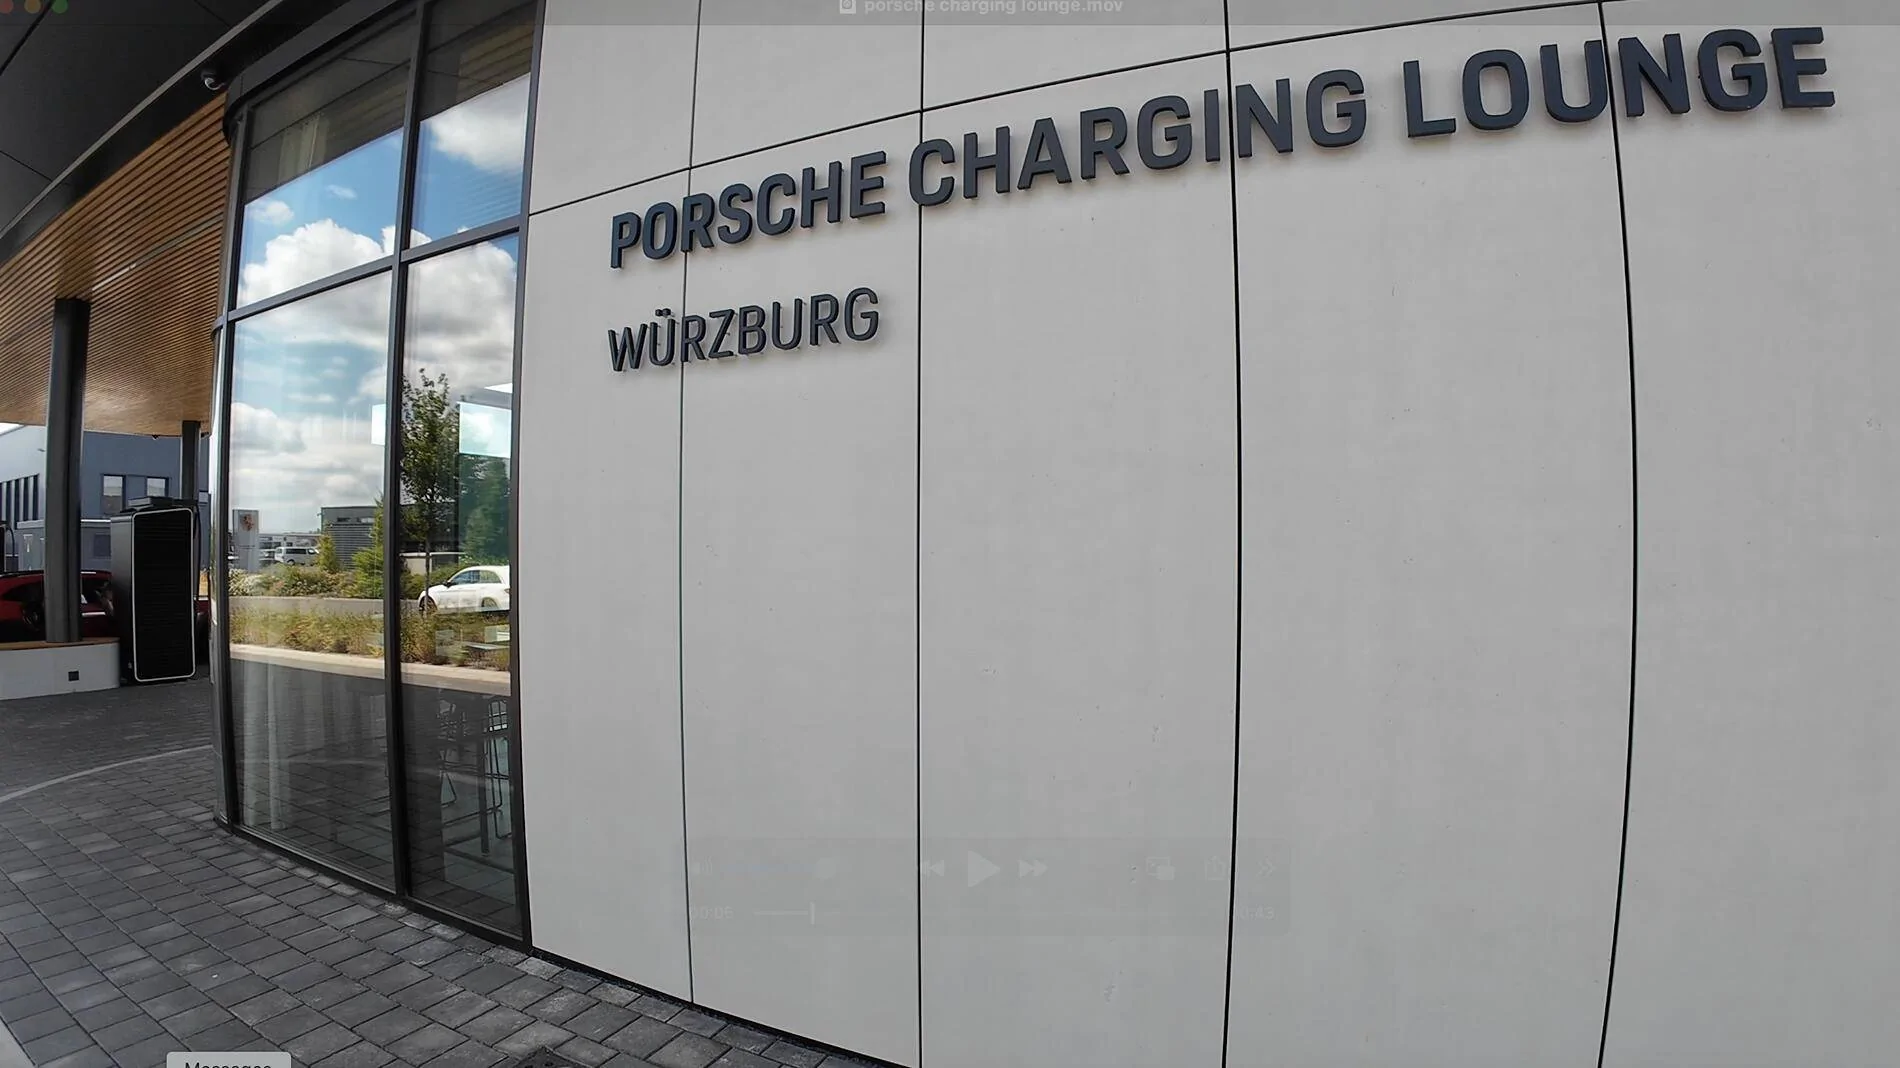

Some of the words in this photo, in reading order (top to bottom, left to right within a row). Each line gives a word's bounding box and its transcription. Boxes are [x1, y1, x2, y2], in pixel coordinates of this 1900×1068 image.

[609, 150, 887, 269] PORSCHE
[908, 69, 1368, 207] CHARGING
[1402, 26, 1836, 138] LOUNGE
[607, 286, 880, 372] WÜRZBURG
